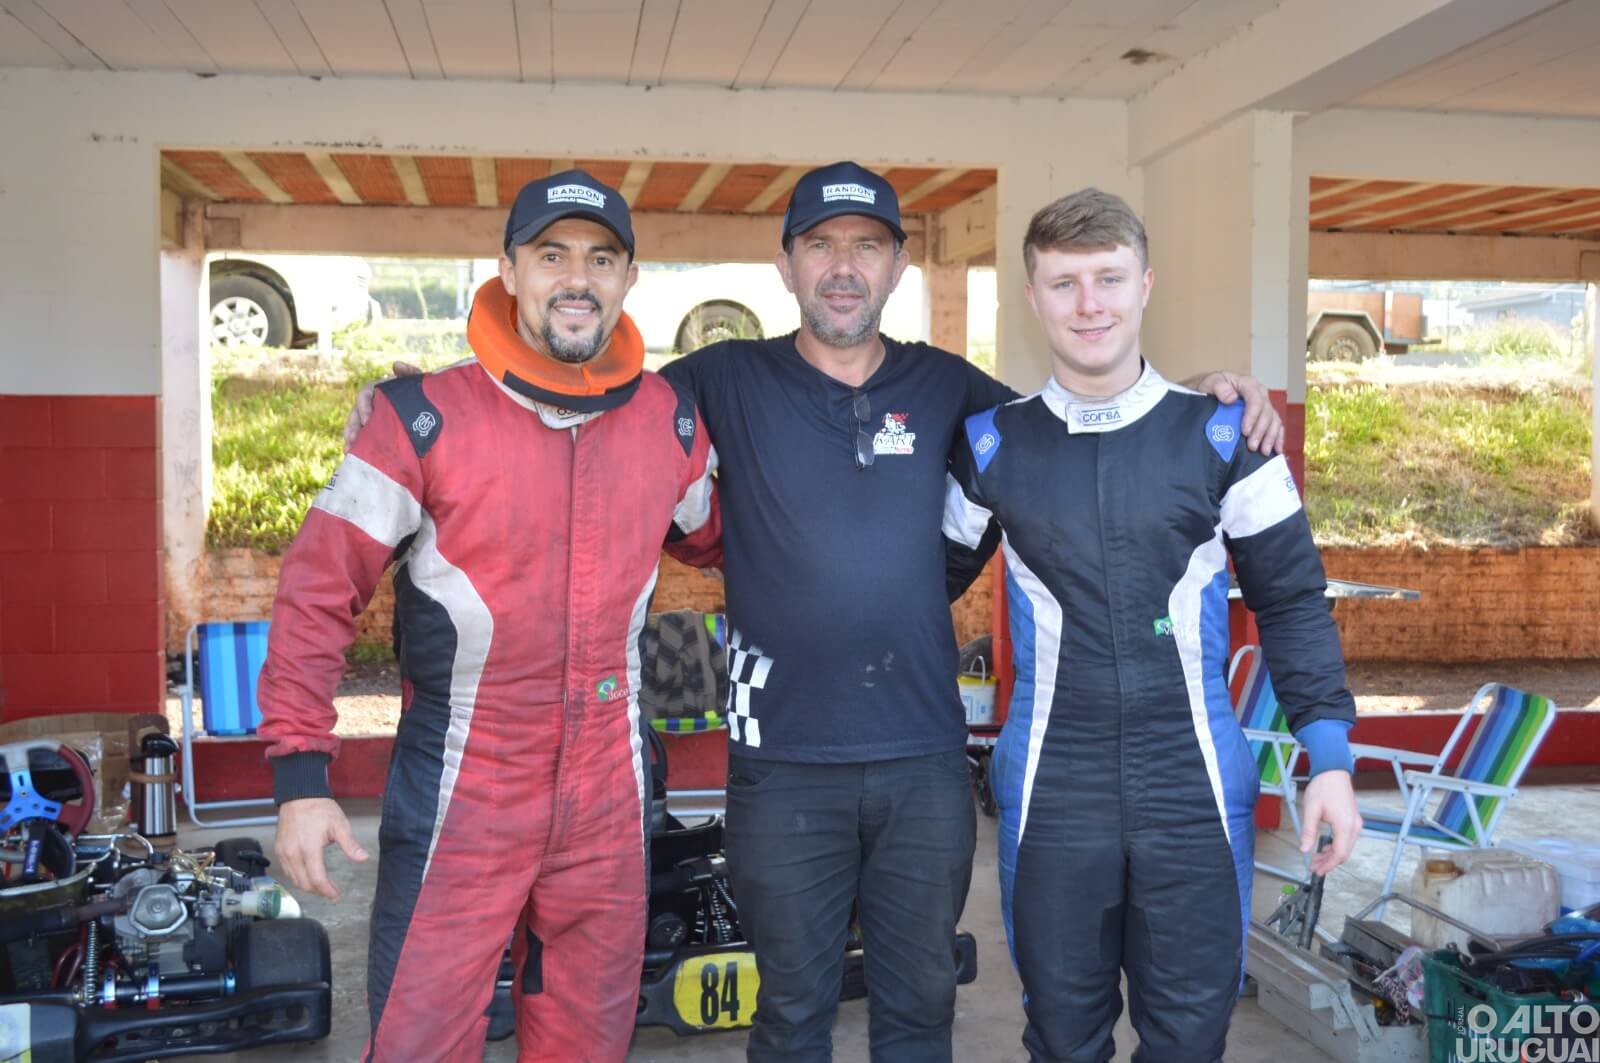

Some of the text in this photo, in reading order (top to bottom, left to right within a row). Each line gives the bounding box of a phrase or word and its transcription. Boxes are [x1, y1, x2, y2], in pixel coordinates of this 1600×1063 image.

[551, 187, 601, 201] RANDON
[825, 185, 872, 197] RANDON
[700, 961, 740, 1026] 84
